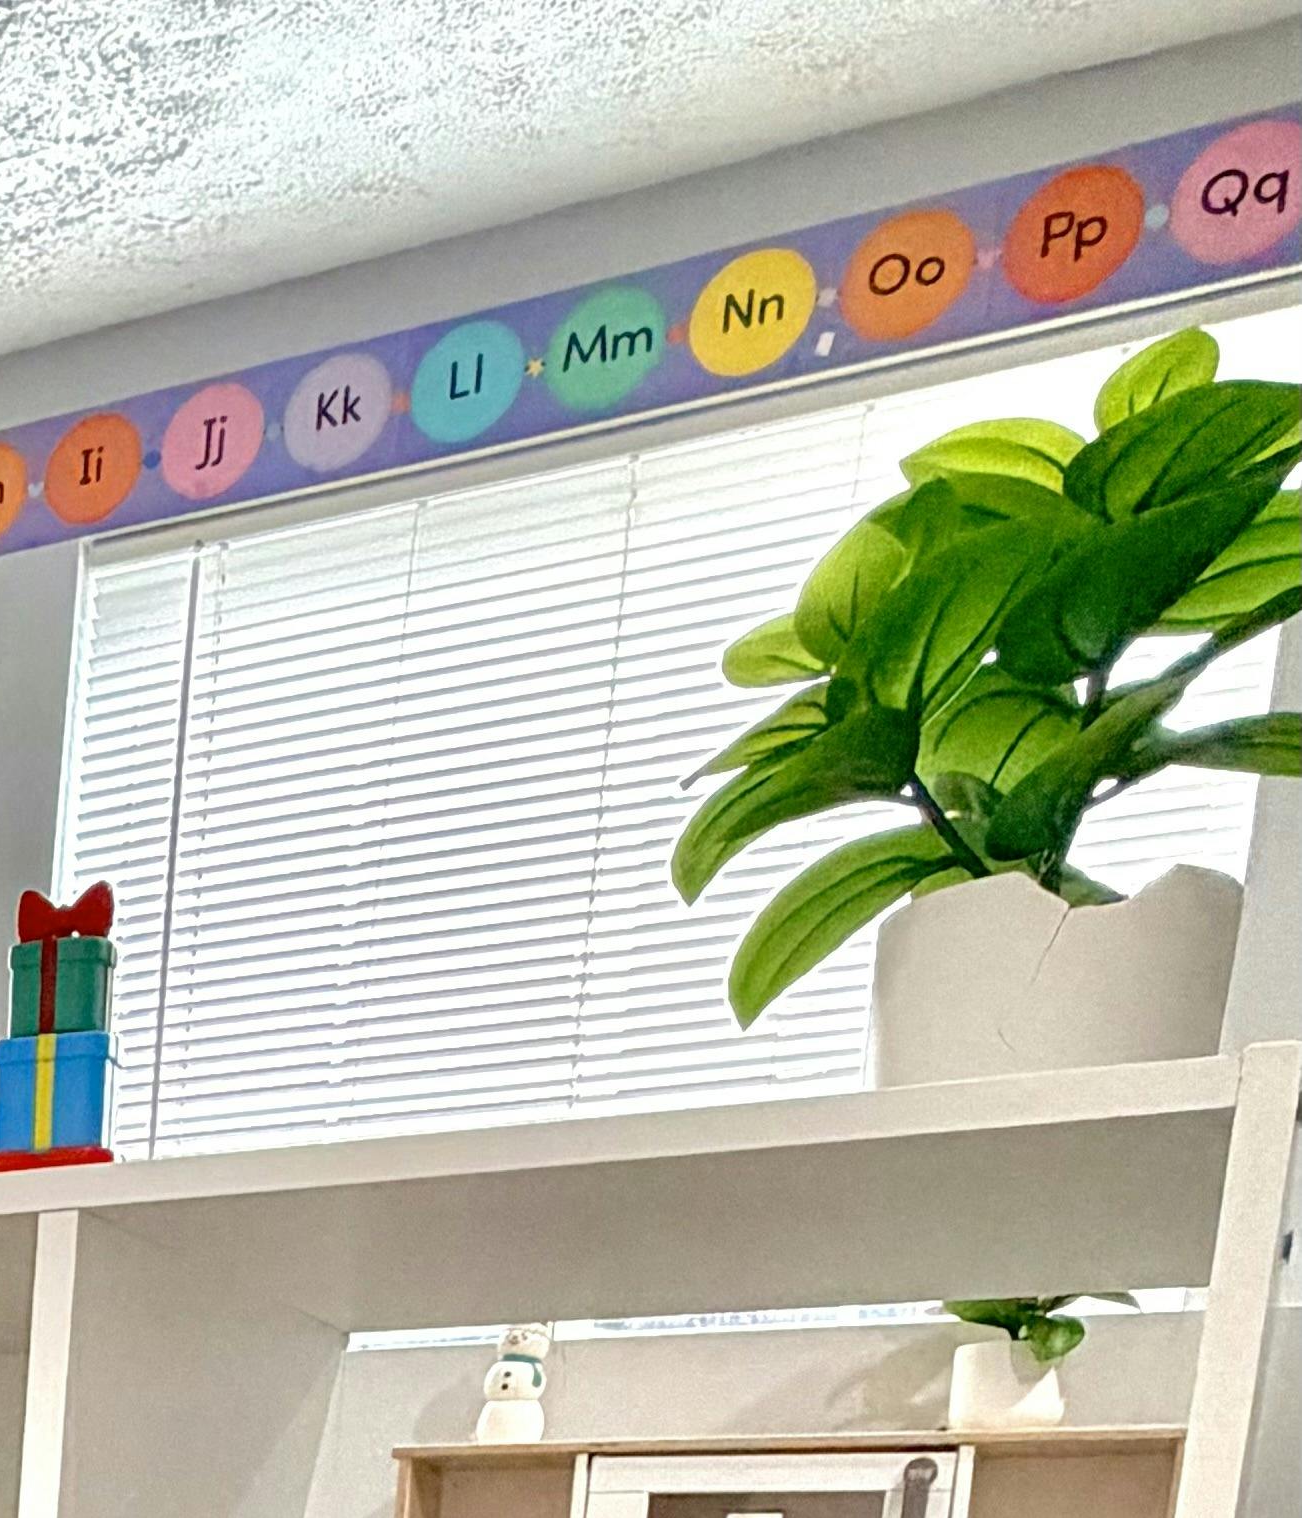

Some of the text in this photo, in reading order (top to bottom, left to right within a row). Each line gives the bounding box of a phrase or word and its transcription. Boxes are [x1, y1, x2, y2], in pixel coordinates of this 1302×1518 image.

[194, 414, 229, 472] Jj
[315, 384, 362, 432] Kk
[561, 324, 654, 374] Mm
[721, 288, 786, 334] Nn
[868, 252, 946, 297] Oo
[1039, 210, 1109, 263] Pp
[1200, 167, 1291, 218] Qq
